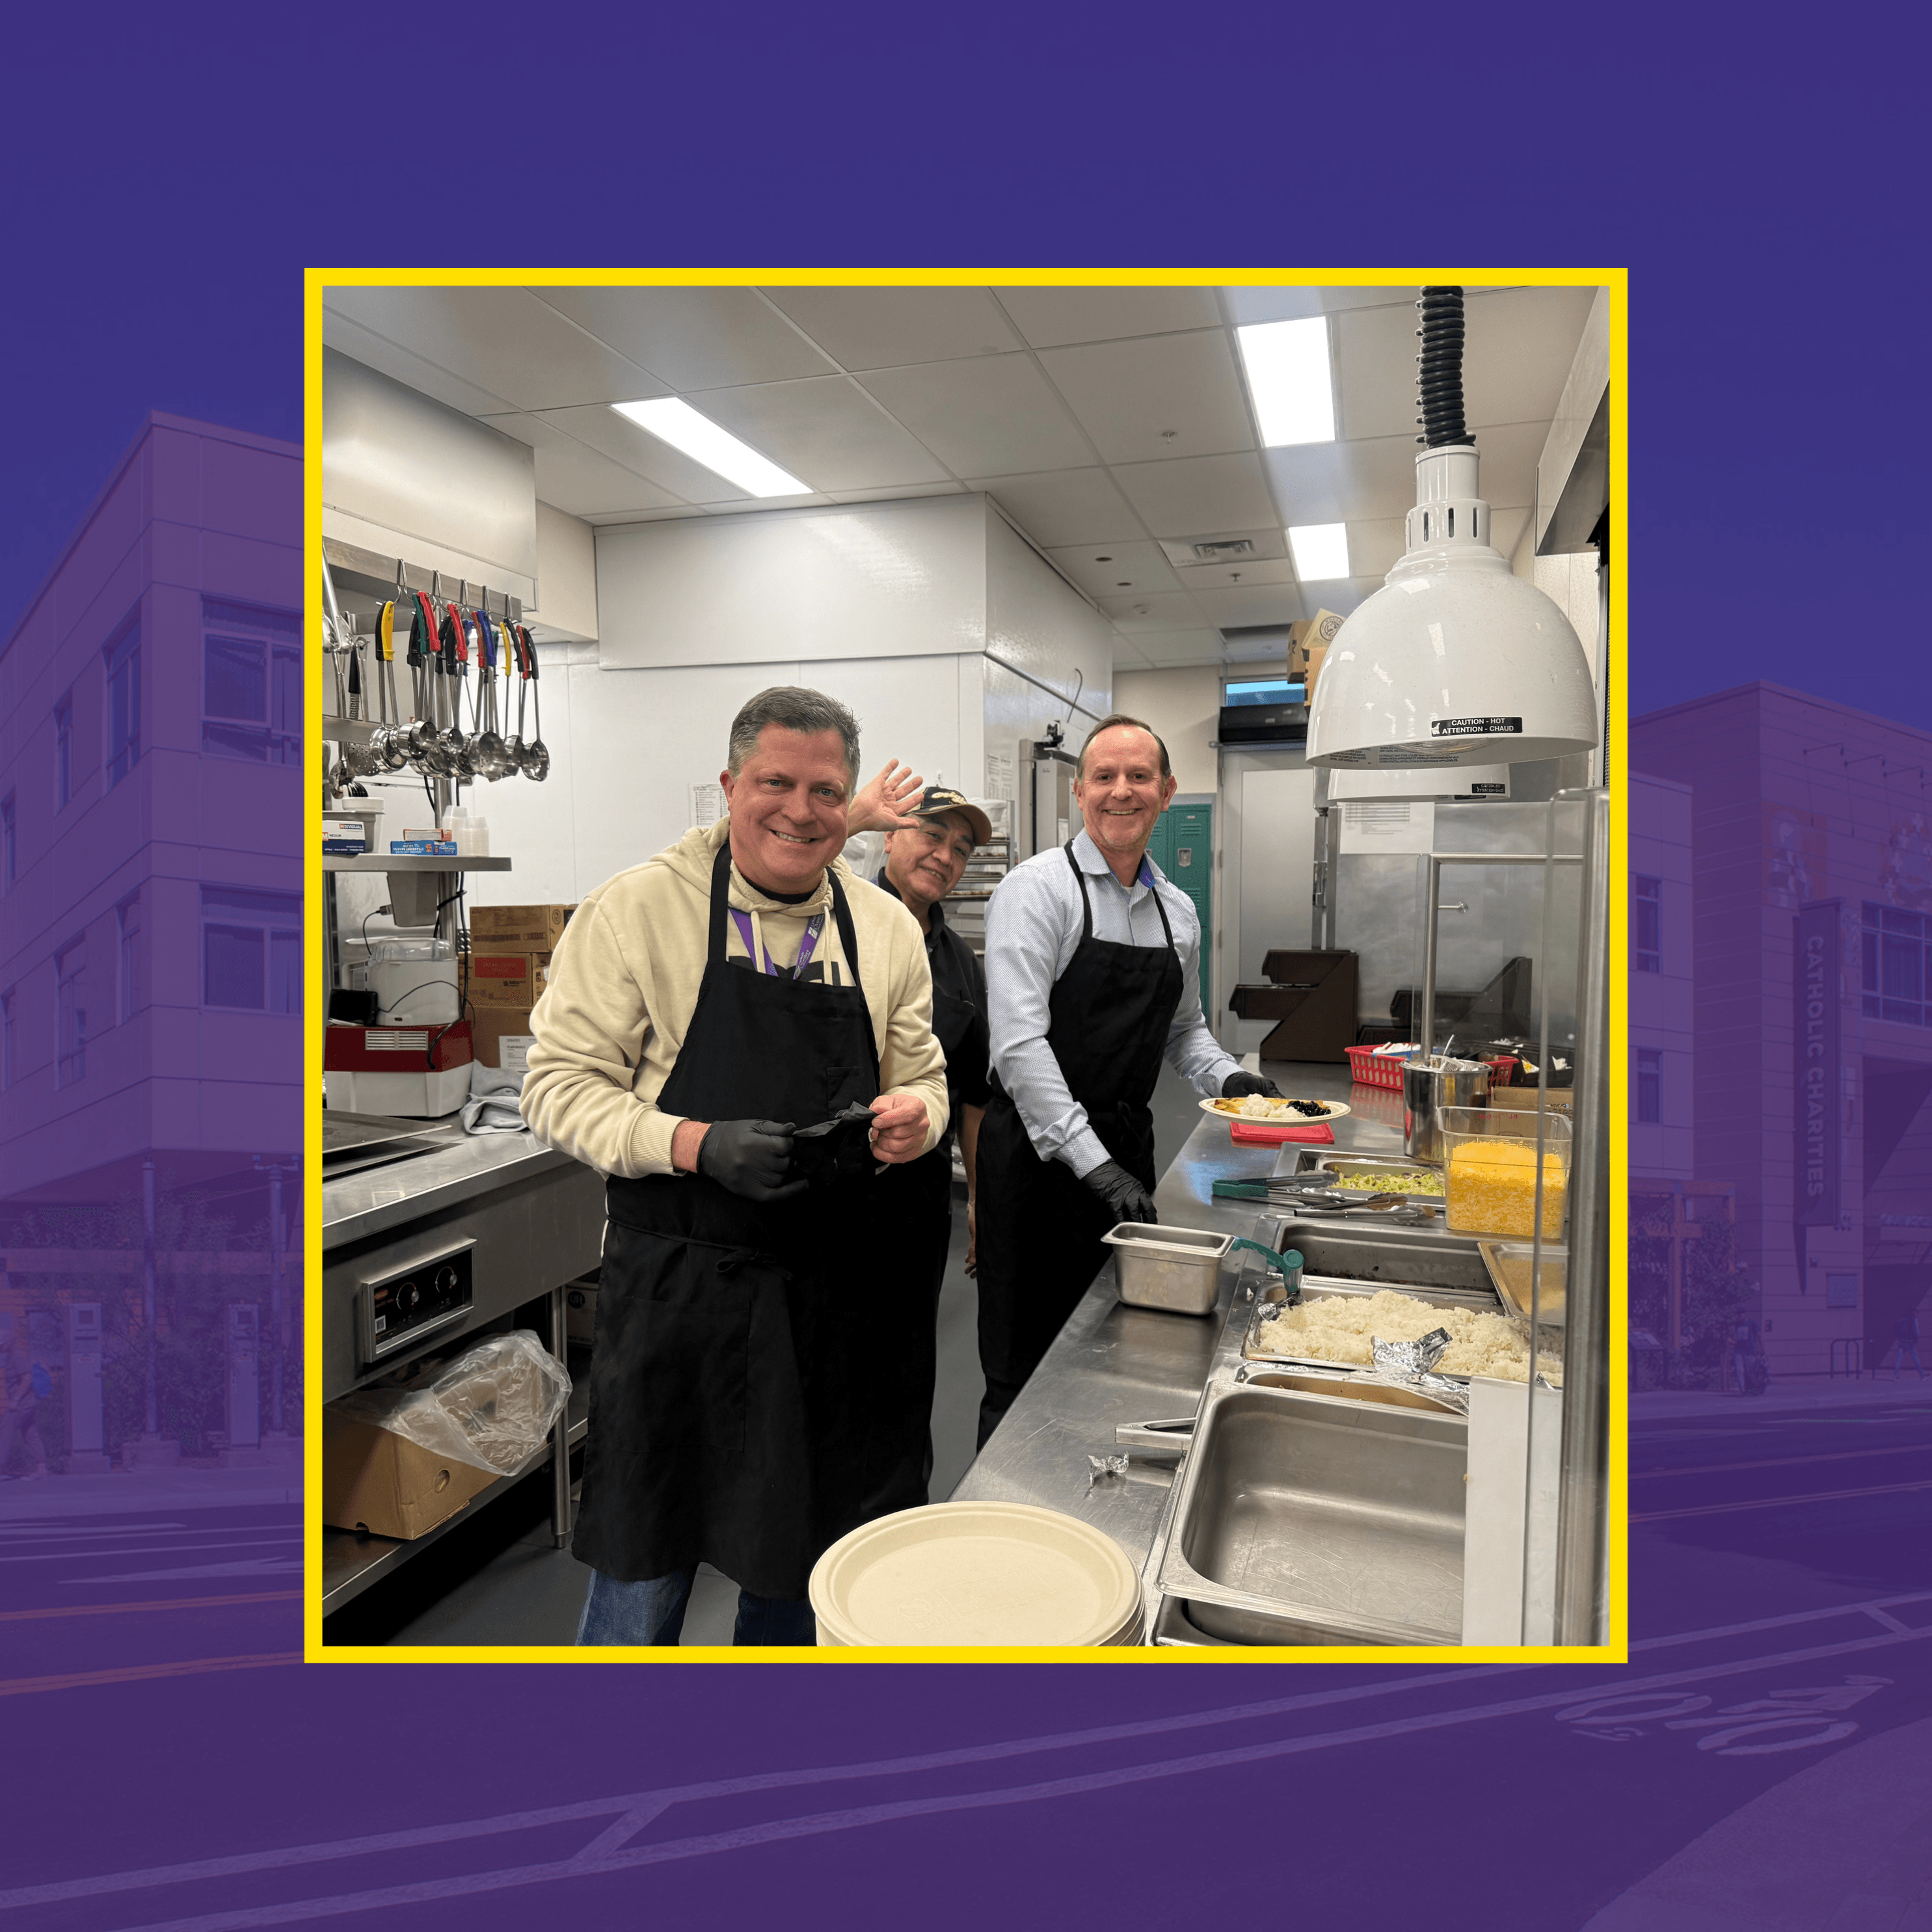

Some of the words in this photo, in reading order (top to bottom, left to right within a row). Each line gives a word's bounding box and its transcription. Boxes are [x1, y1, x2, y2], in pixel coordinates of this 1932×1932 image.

[1442, 726, 1483, 734] ATTENTION
[1806, 935, 1825, 1058] CATHOLIC
[1806, 1066, 1825, 1198] CHARITIES
